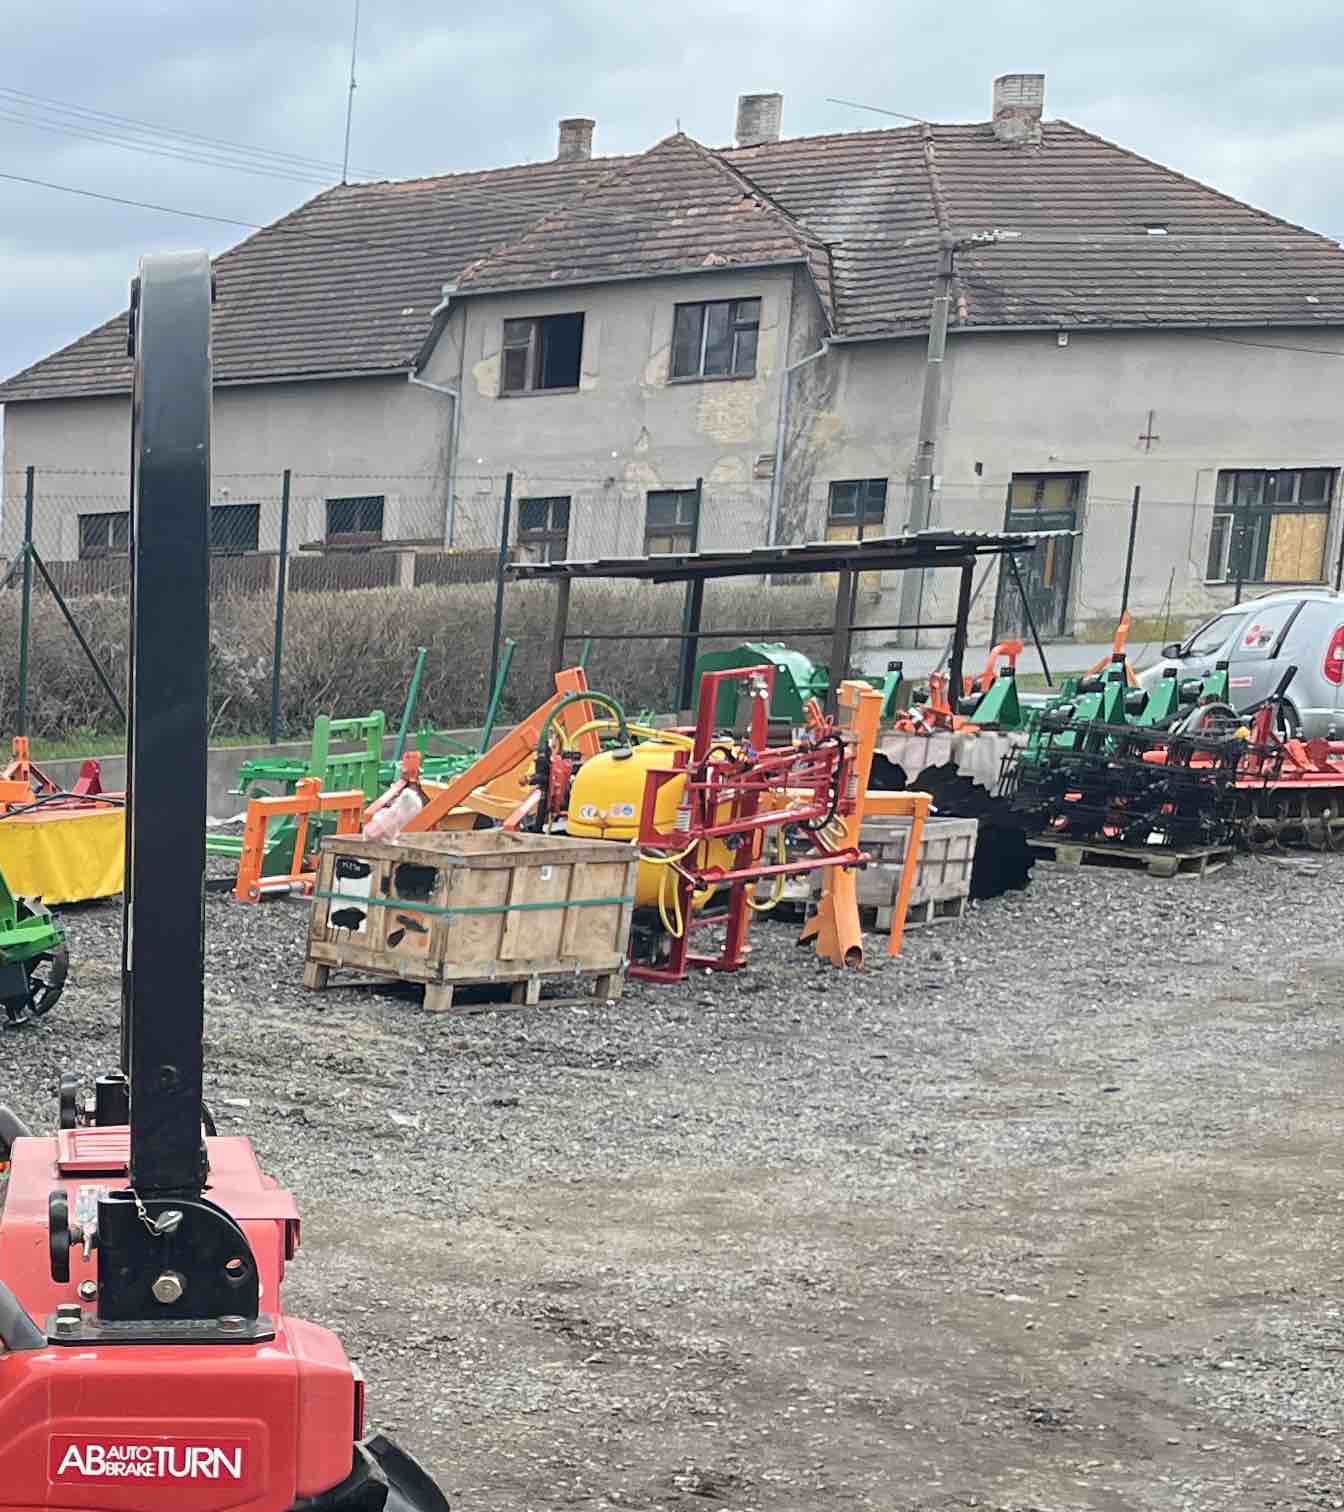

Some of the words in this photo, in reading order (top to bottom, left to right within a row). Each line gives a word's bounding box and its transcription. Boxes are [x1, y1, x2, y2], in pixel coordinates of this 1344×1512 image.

[57, 1444, 106, 1476] AB
[107, 1445, 153, 1461] AUTO
[152, 1446, 243, 1479] TURN
[105, 1461, 157, 1477] BRAKE
